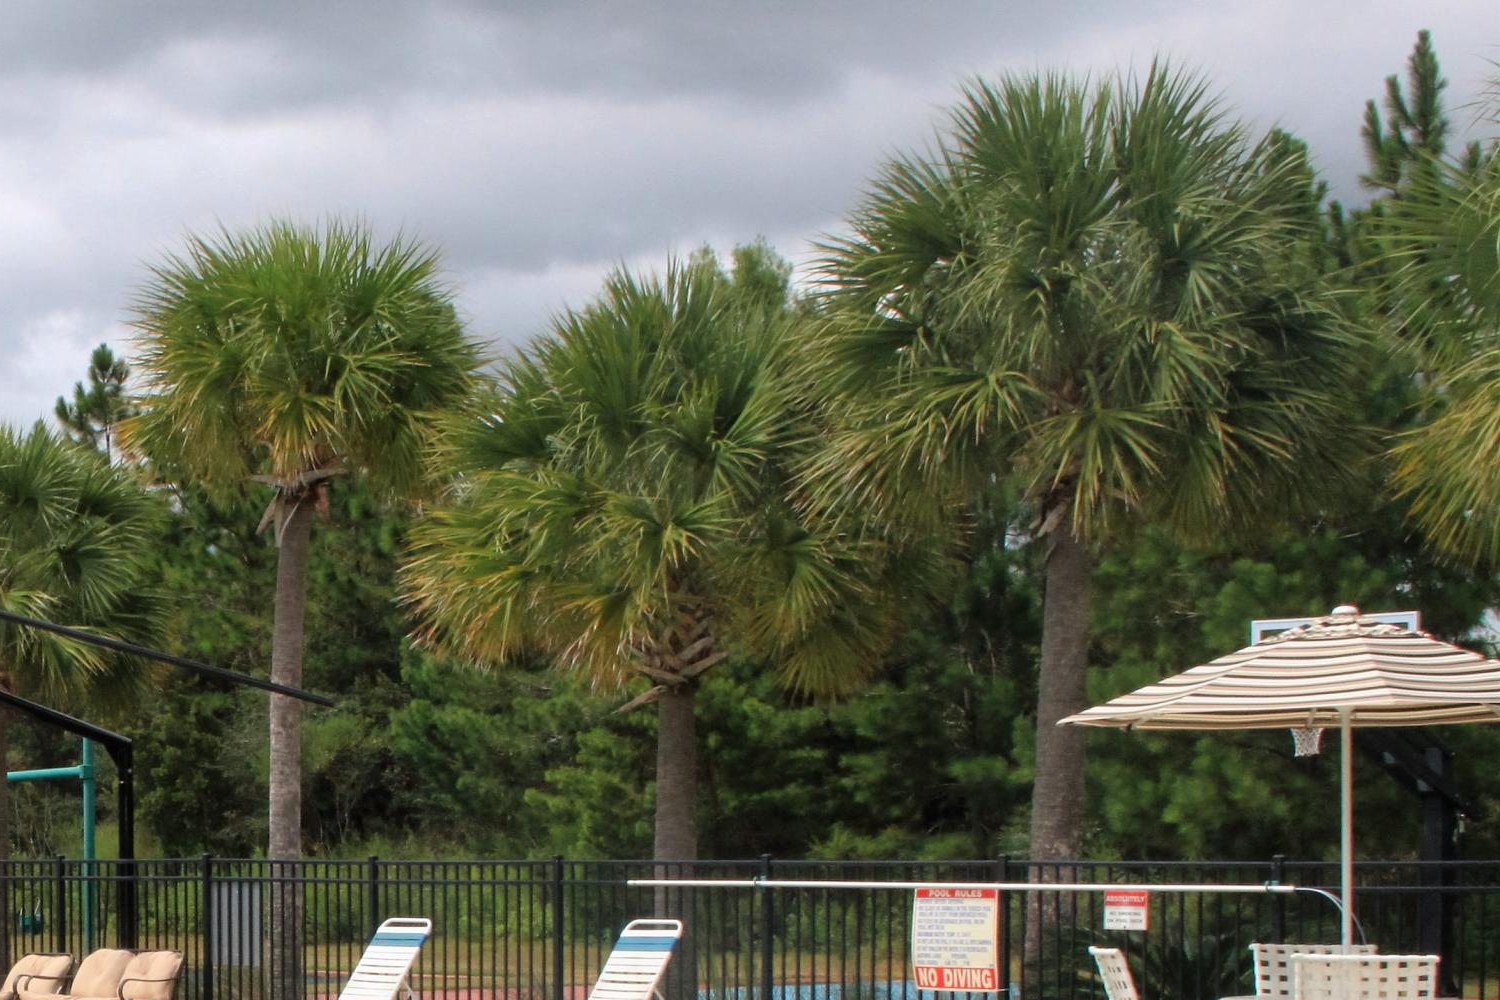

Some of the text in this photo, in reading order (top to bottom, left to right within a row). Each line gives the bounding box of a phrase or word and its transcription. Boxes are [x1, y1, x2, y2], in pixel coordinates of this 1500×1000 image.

[929, 889, 982, 898] POOL RULES
[918, 968, 992, 989] NO DIVING
